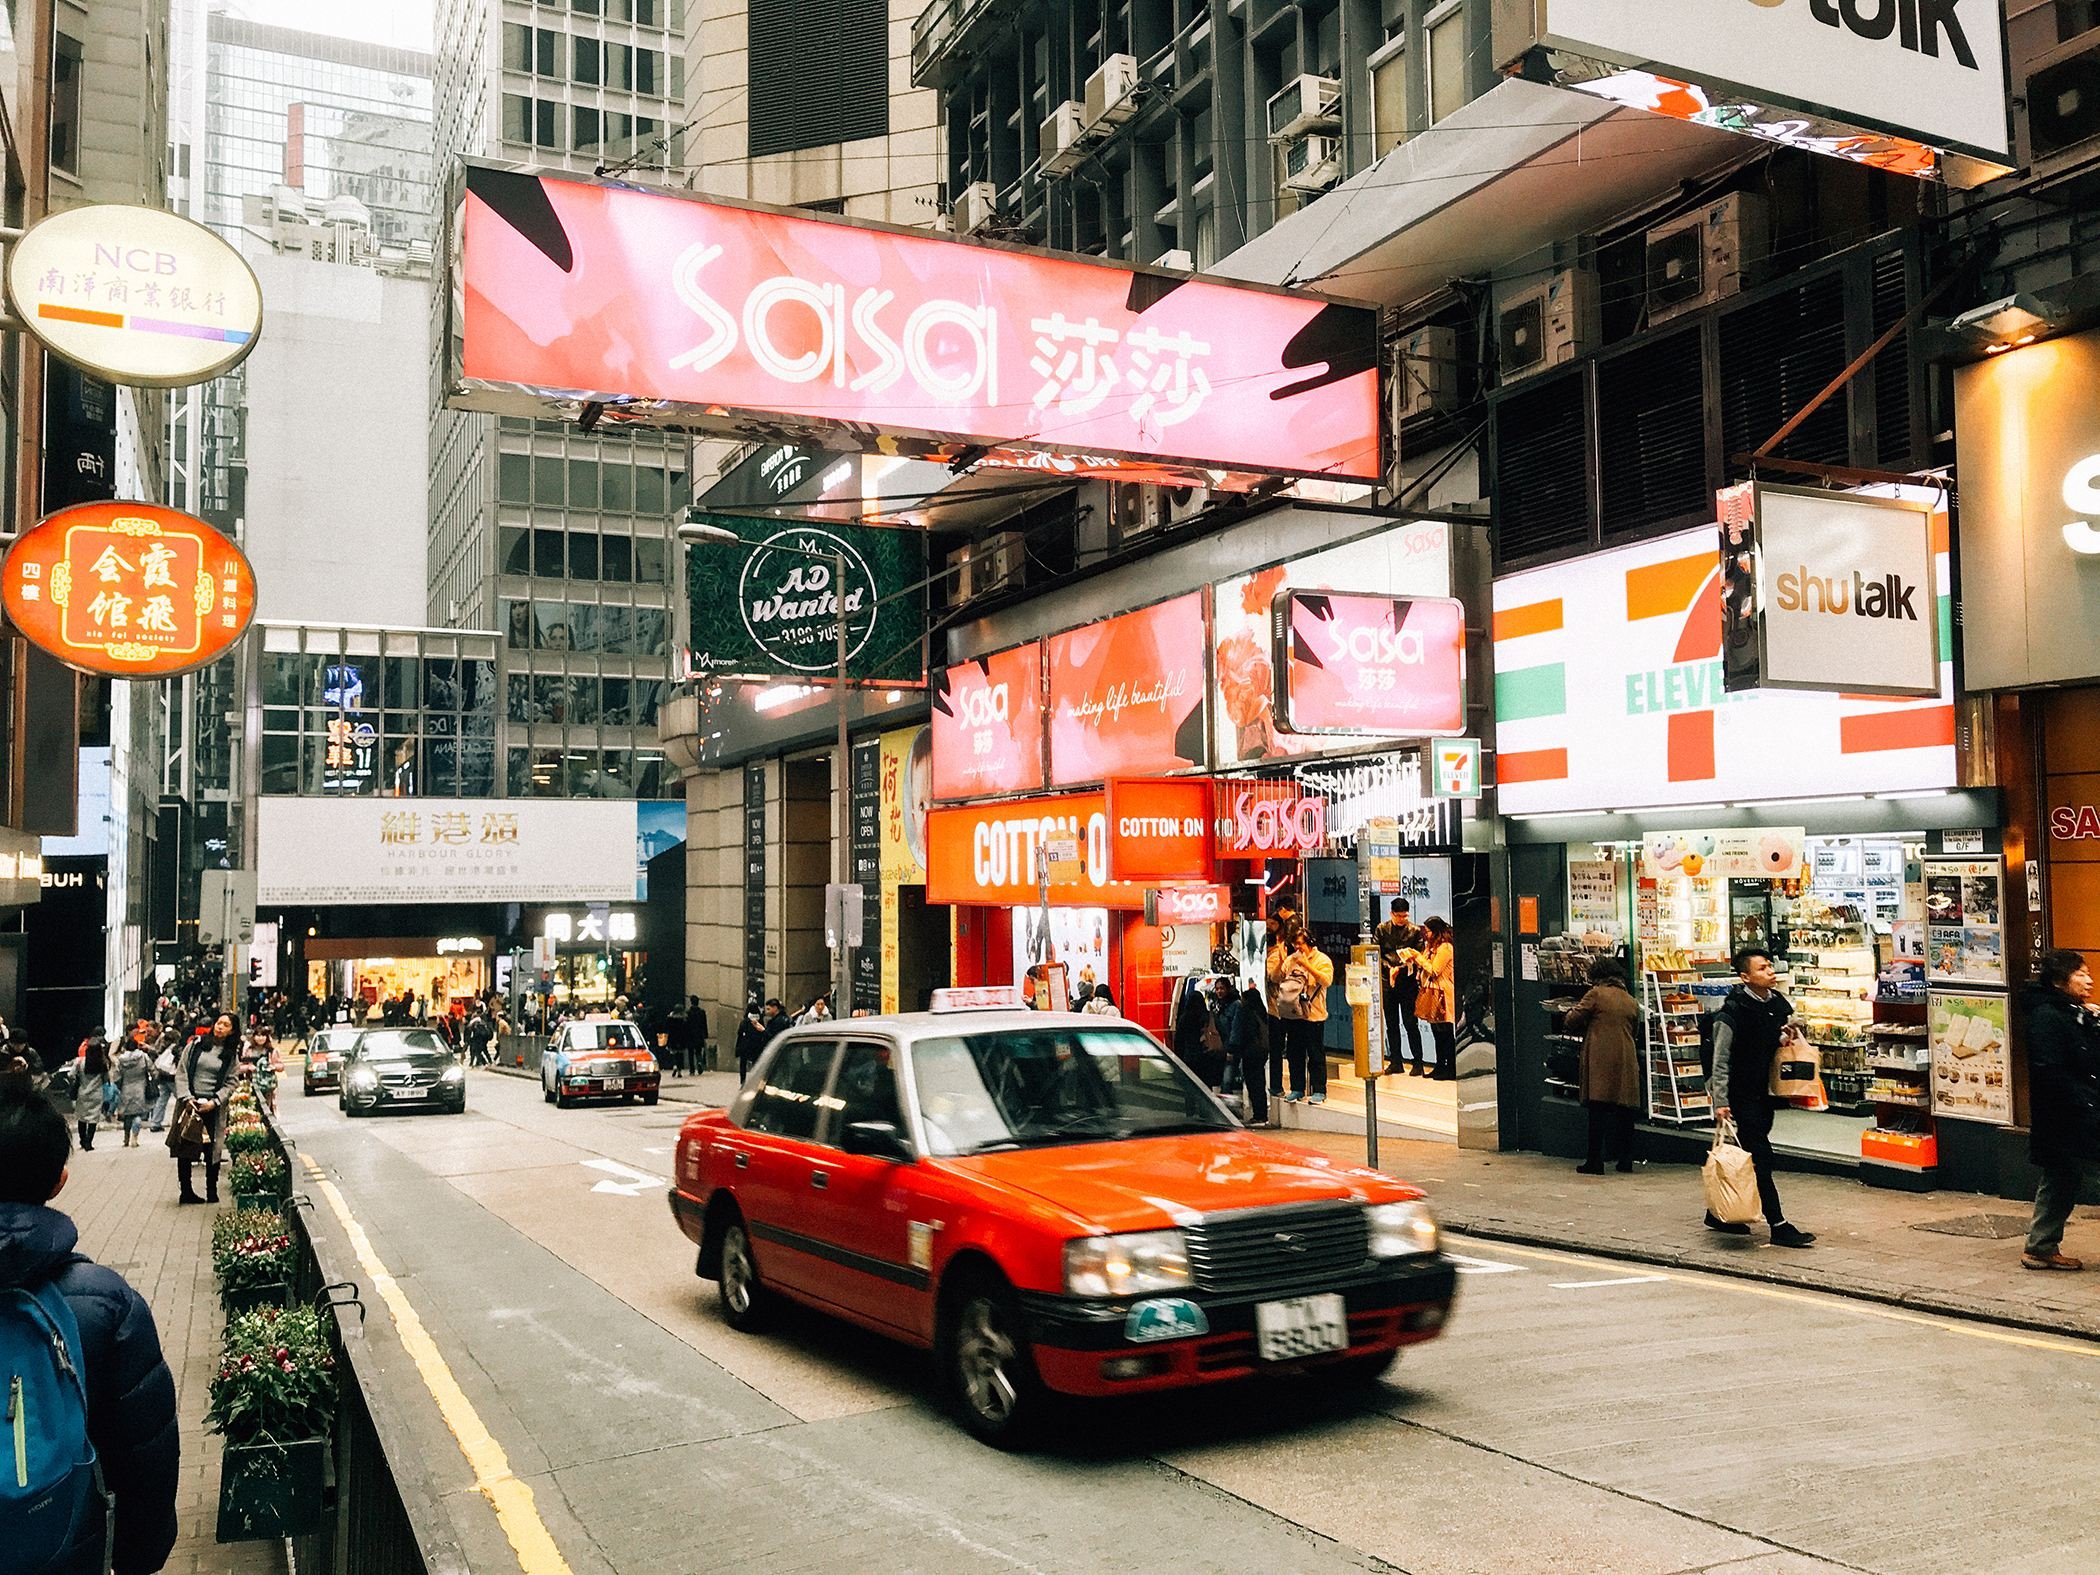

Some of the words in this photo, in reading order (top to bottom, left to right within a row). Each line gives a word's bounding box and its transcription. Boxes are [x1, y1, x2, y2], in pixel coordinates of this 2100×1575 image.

[95, 243, 177, 275] NCB
[39, 267, 226, 317] 南洋商業銀行
[1031, 313, 1211, 428] 莎莎
[777, 565, 830, 594] AD
[1776, 565, 1848, 615] shu
[1854, 571, 1918, 621] talk
[752, 587, 864, 622] Wanted
[136, 633, 175, 643] society
[1358, 667, 1396, 690] 莎莎
[1106, 682, 1130, 723] life
[1131, 669, 1186, 713] beautiful
[1444, 752, 1467, 792] 7
[860, 805, 874, 818] NOW
[381, 811, 520, 846] 維港頌
[860, 825, 874, 837] OPEN
[1120, 817, 1179, 837] COTTON
[1184, 818, 1204, 837] ON
[388, 849, 457, 858] HARBOUR
[466, 849, 512, 858] GLORY
[1401, 875, 1428, 887] Cyber
[1401, 886, 1430, 898] Colors
